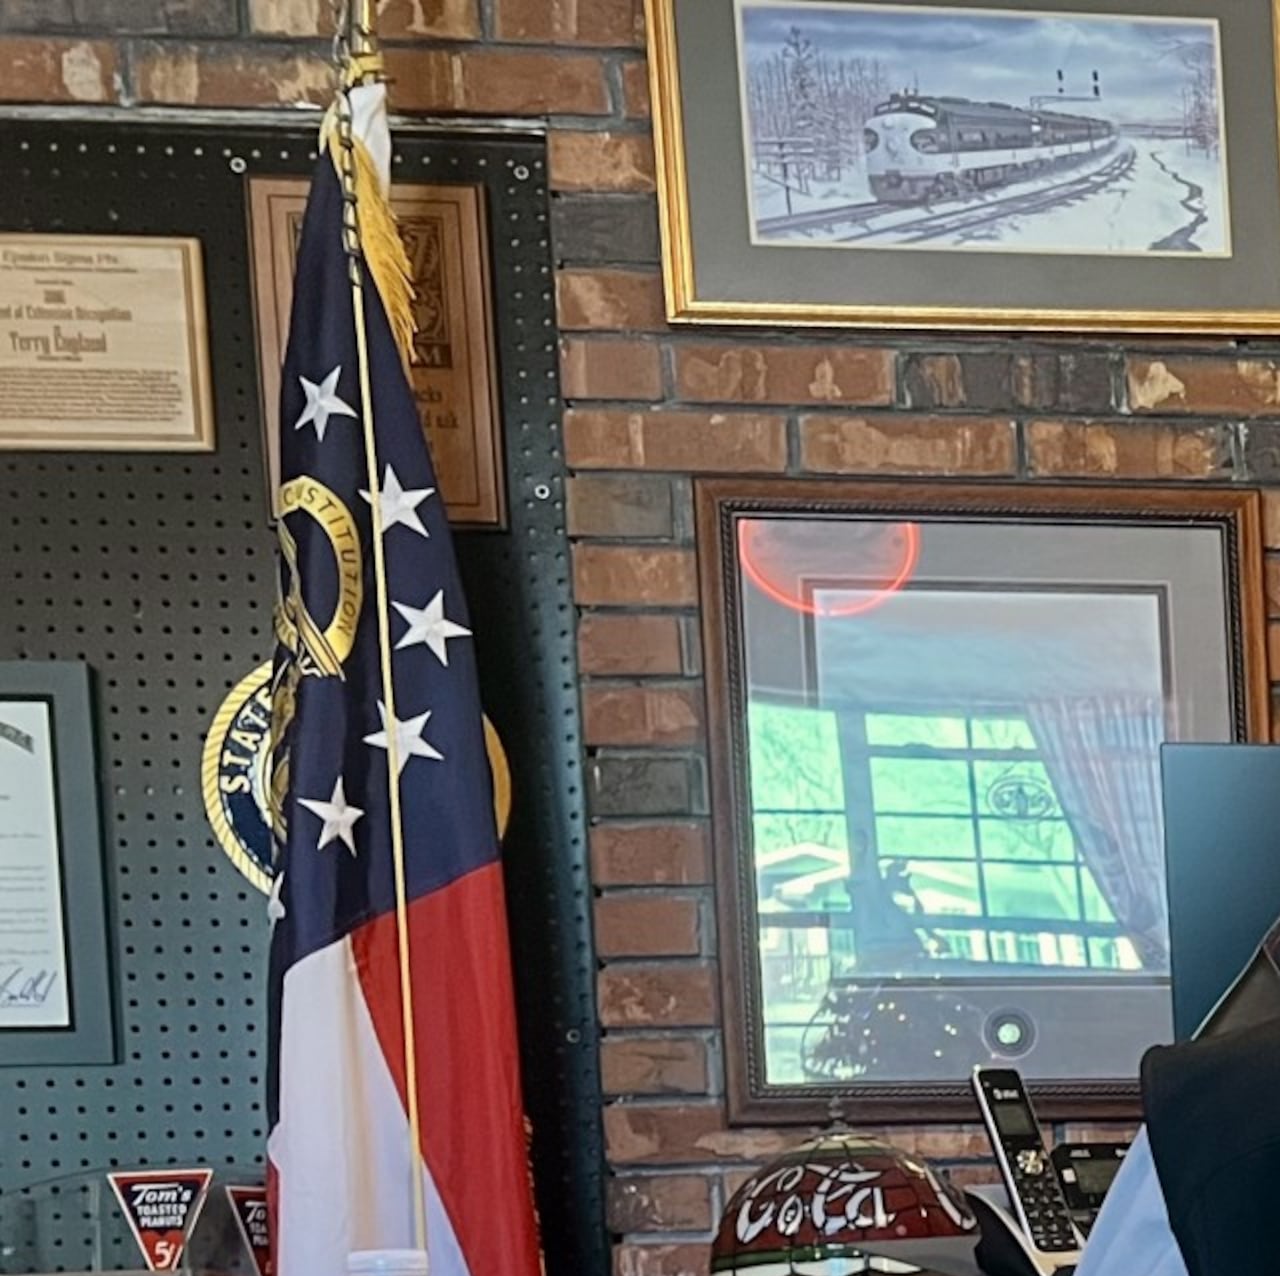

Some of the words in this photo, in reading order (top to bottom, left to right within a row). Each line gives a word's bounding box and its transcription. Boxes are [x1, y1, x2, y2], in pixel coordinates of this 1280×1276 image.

[131, 1183, 192, 1206] Tom's
[136, 1204, 188, 1217] TOASTED
[141, 1216, 184, 1229] PEANUTS
